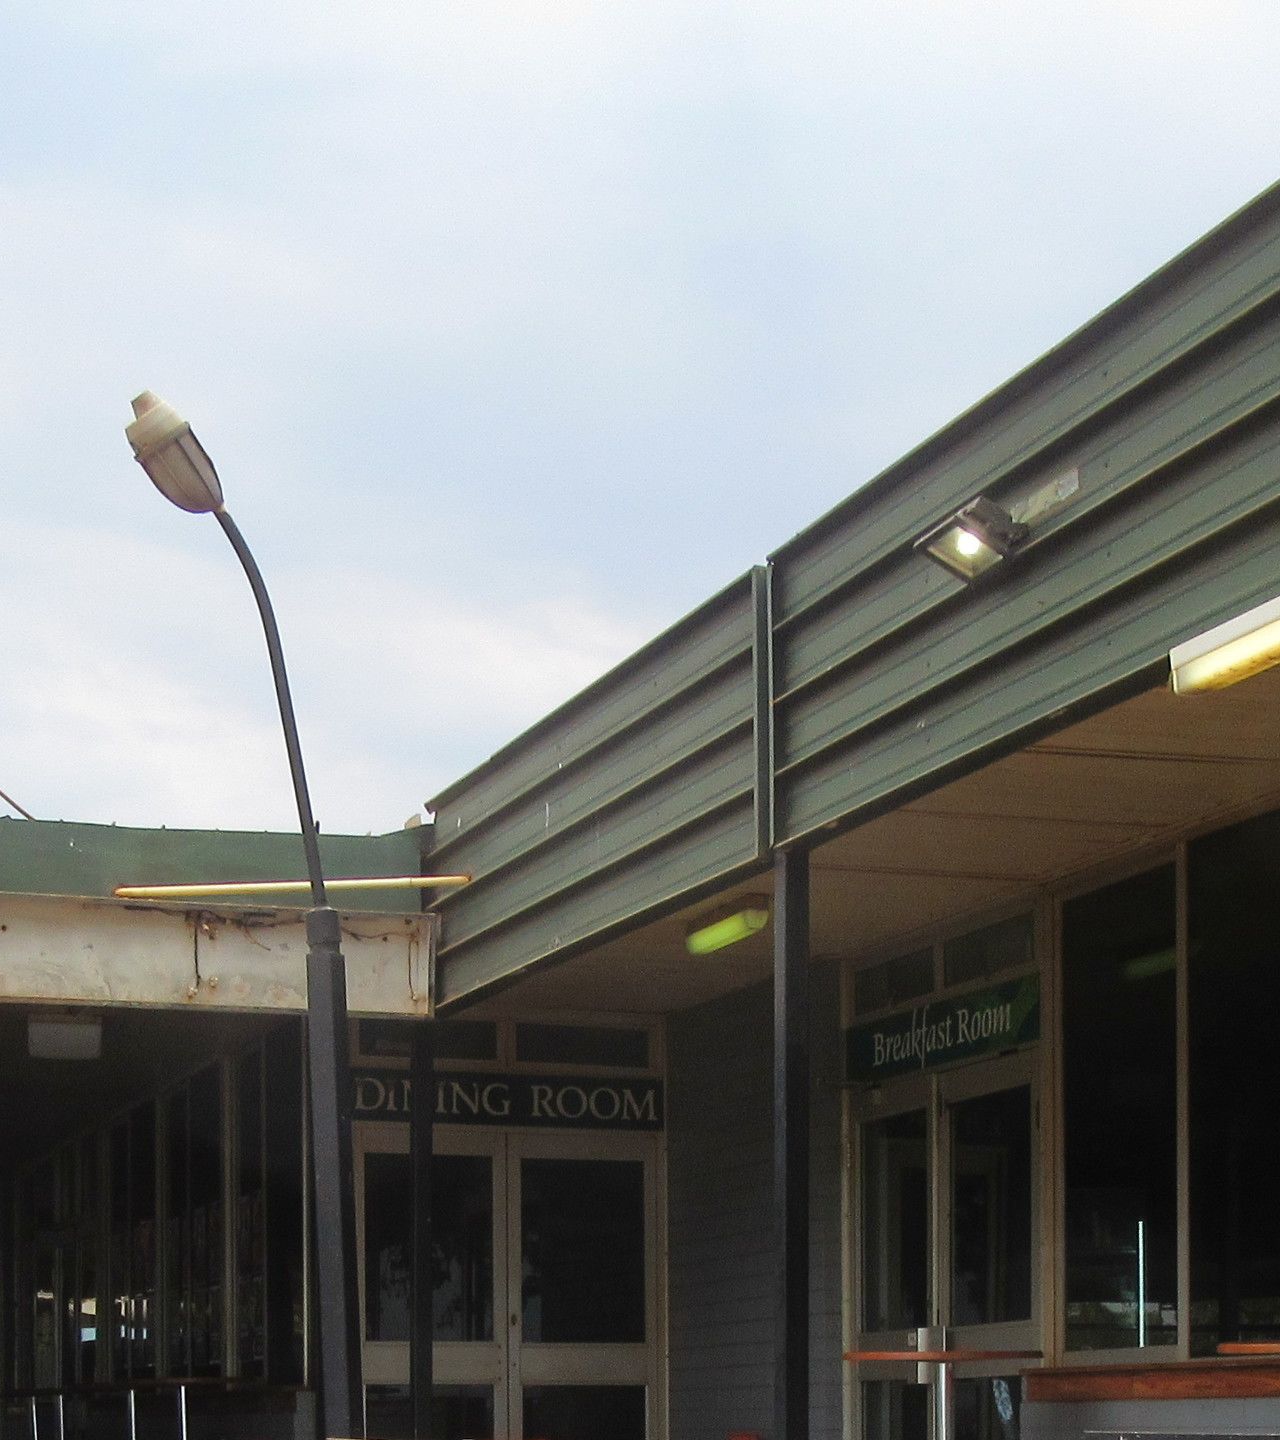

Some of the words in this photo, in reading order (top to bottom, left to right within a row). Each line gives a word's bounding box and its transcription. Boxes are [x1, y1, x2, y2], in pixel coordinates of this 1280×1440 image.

[872, 1003, 954, 1069] Breakfast
[956, 1003, 1011, 1043] Room
[530, 1084, 660, 1122] ROOM
